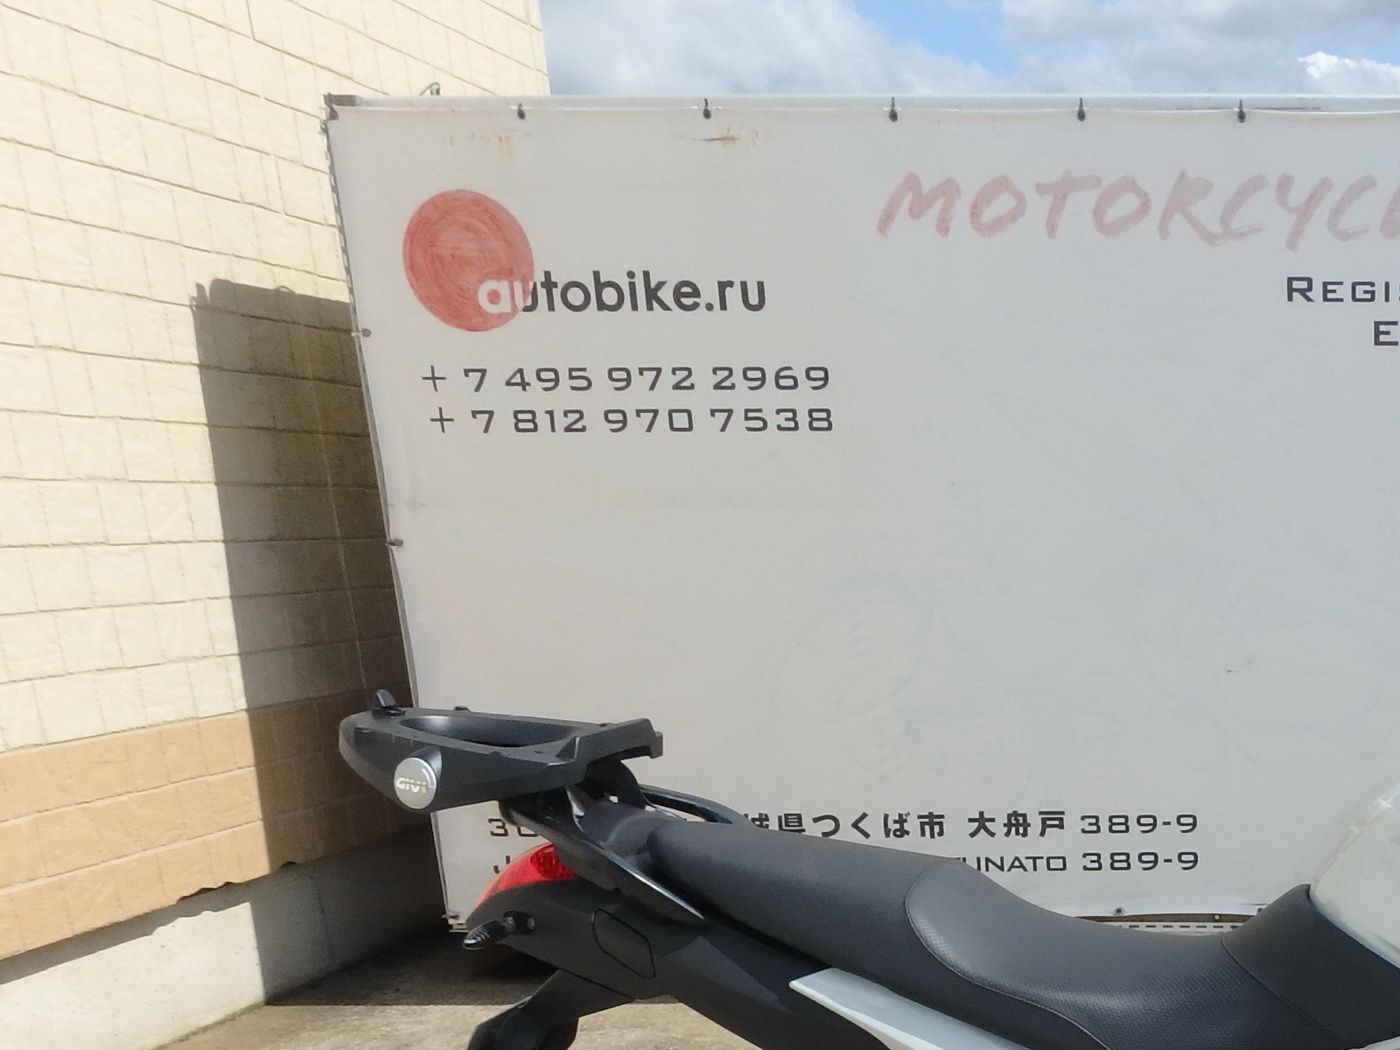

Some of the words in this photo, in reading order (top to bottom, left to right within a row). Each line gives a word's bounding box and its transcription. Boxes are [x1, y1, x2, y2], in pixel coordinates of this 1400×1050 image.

[478, 270, 766, 314] autobike.ru
[504, 367, 593, 393] 495
[607, 366, 696, 392] 972
[711, 365, 830, 391] 2969
[512, 409, 587, 434] 812
[603, 408, 694, 434] 970
[709, 407, 833, 433] 7538
[967, 810, 1066, 839] 大舟戸
[1080, 814, 1198, 835] 389-9
[1081, 851, 1199, 872] 389-9
